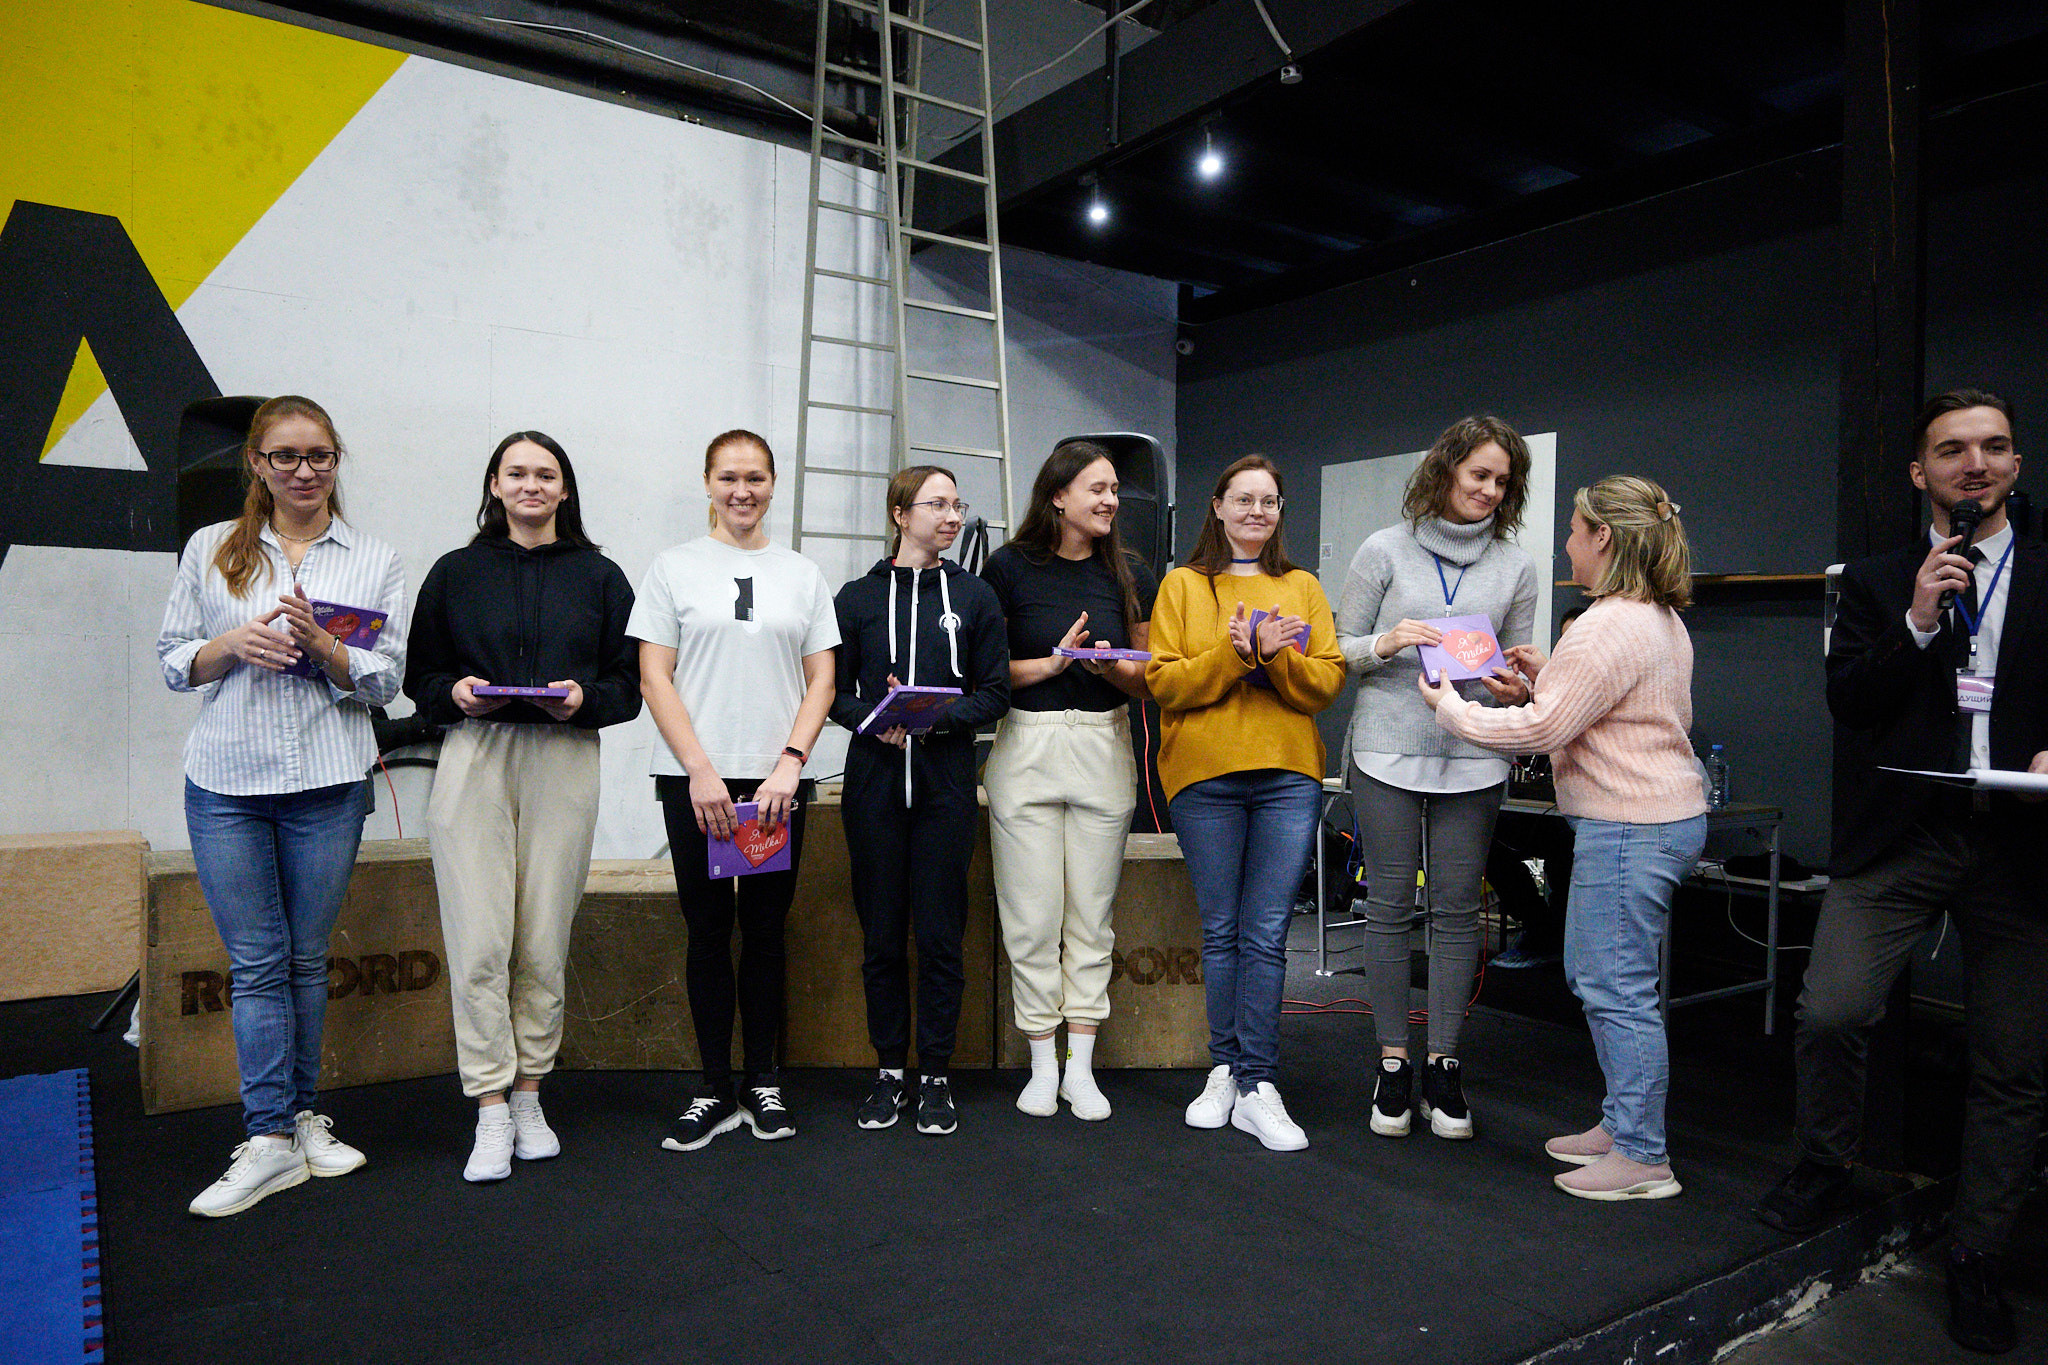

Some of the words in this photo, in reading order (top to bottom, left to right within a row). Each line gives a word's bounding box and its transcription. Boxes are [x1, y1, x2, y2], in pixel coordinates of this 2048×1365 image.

[1456, 642, 1491, 660] Milka!
[744, 834, 783, 854] Milka!
[181, 950, 440, 1016] RORD
